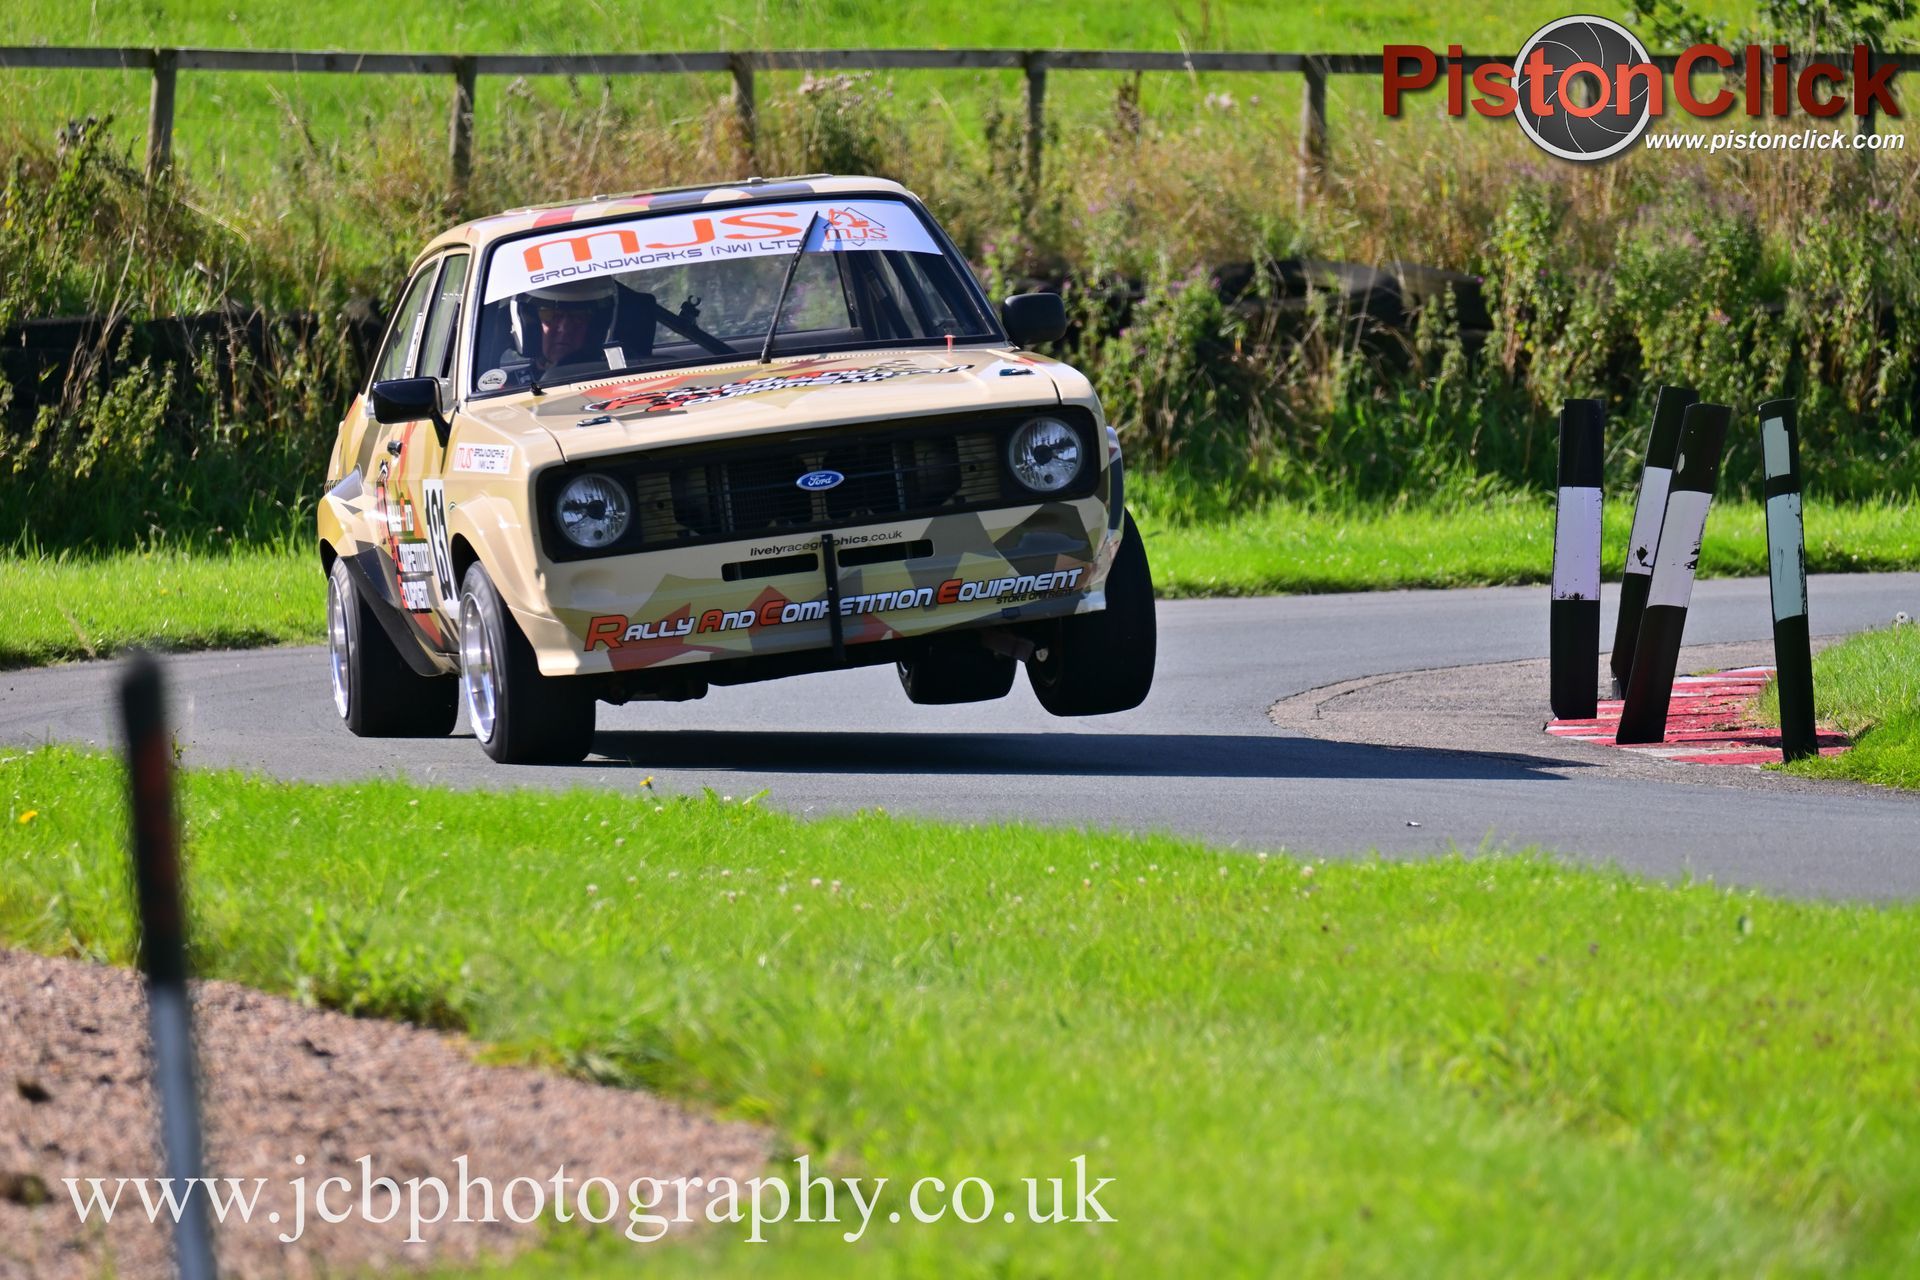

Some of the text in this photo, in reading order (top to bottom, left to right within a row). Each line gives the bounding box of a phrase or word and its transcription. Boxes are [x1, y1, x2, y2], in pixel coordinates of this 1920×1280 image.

[522, 212, 803, 272] MJS
[530, 248, 703, 284] GROUNDWORKS
[761, 238, 803, 252] LTD
[808, 474, 832, 487] Ford
[750, 529, 903, 557] livelyracegrphics.co.uk
[584, 614, 696, 651] RALLY
[697, 608, 757, 634] AND
[936, 567, 1084, 605] EQUIPMENT
